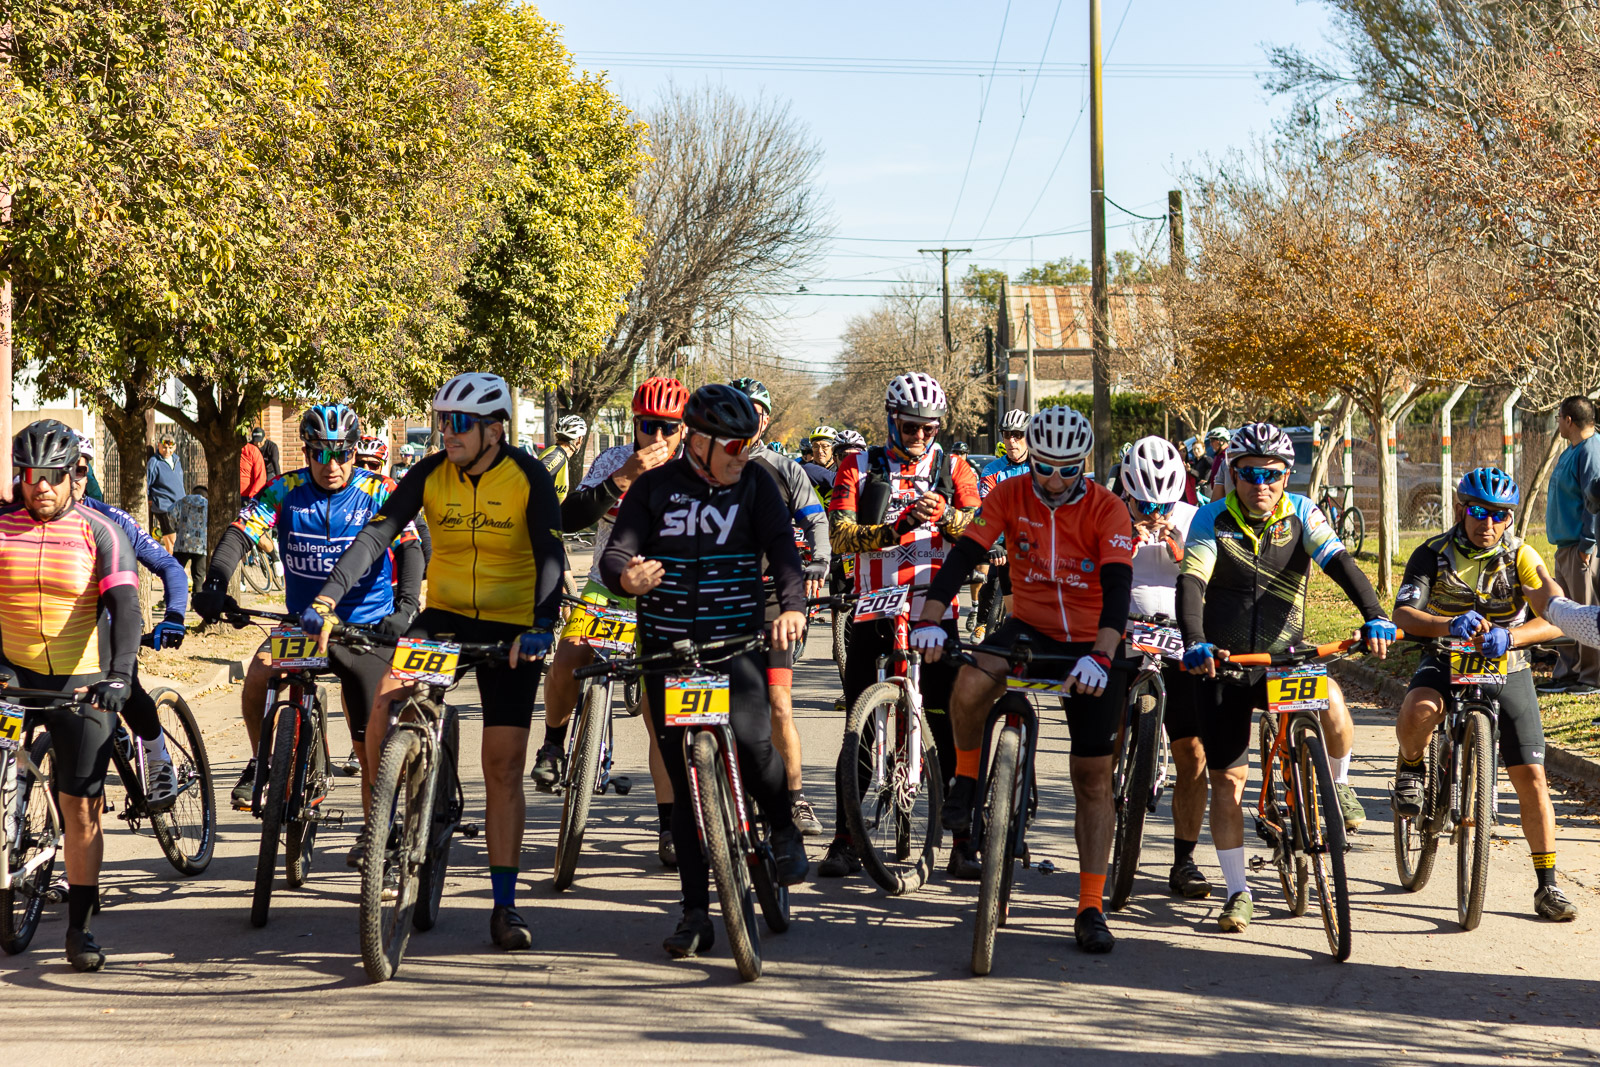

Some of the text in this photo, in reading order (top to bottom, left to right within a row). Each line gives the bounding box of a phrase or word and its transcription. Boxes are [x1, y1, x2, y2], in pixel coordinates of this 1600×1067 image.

[285, 552, 338, 572] autis
[858, 594, 903, 615] 209
[589, 617, 626, 641] 131
[279, 638, 319, 658] 137
[1138, 631, 1181, 651] 216
[403, 651, 448, 673] 68
[1279, 678, 1318, 701] 58
[680, 690, 713, 713] 91
